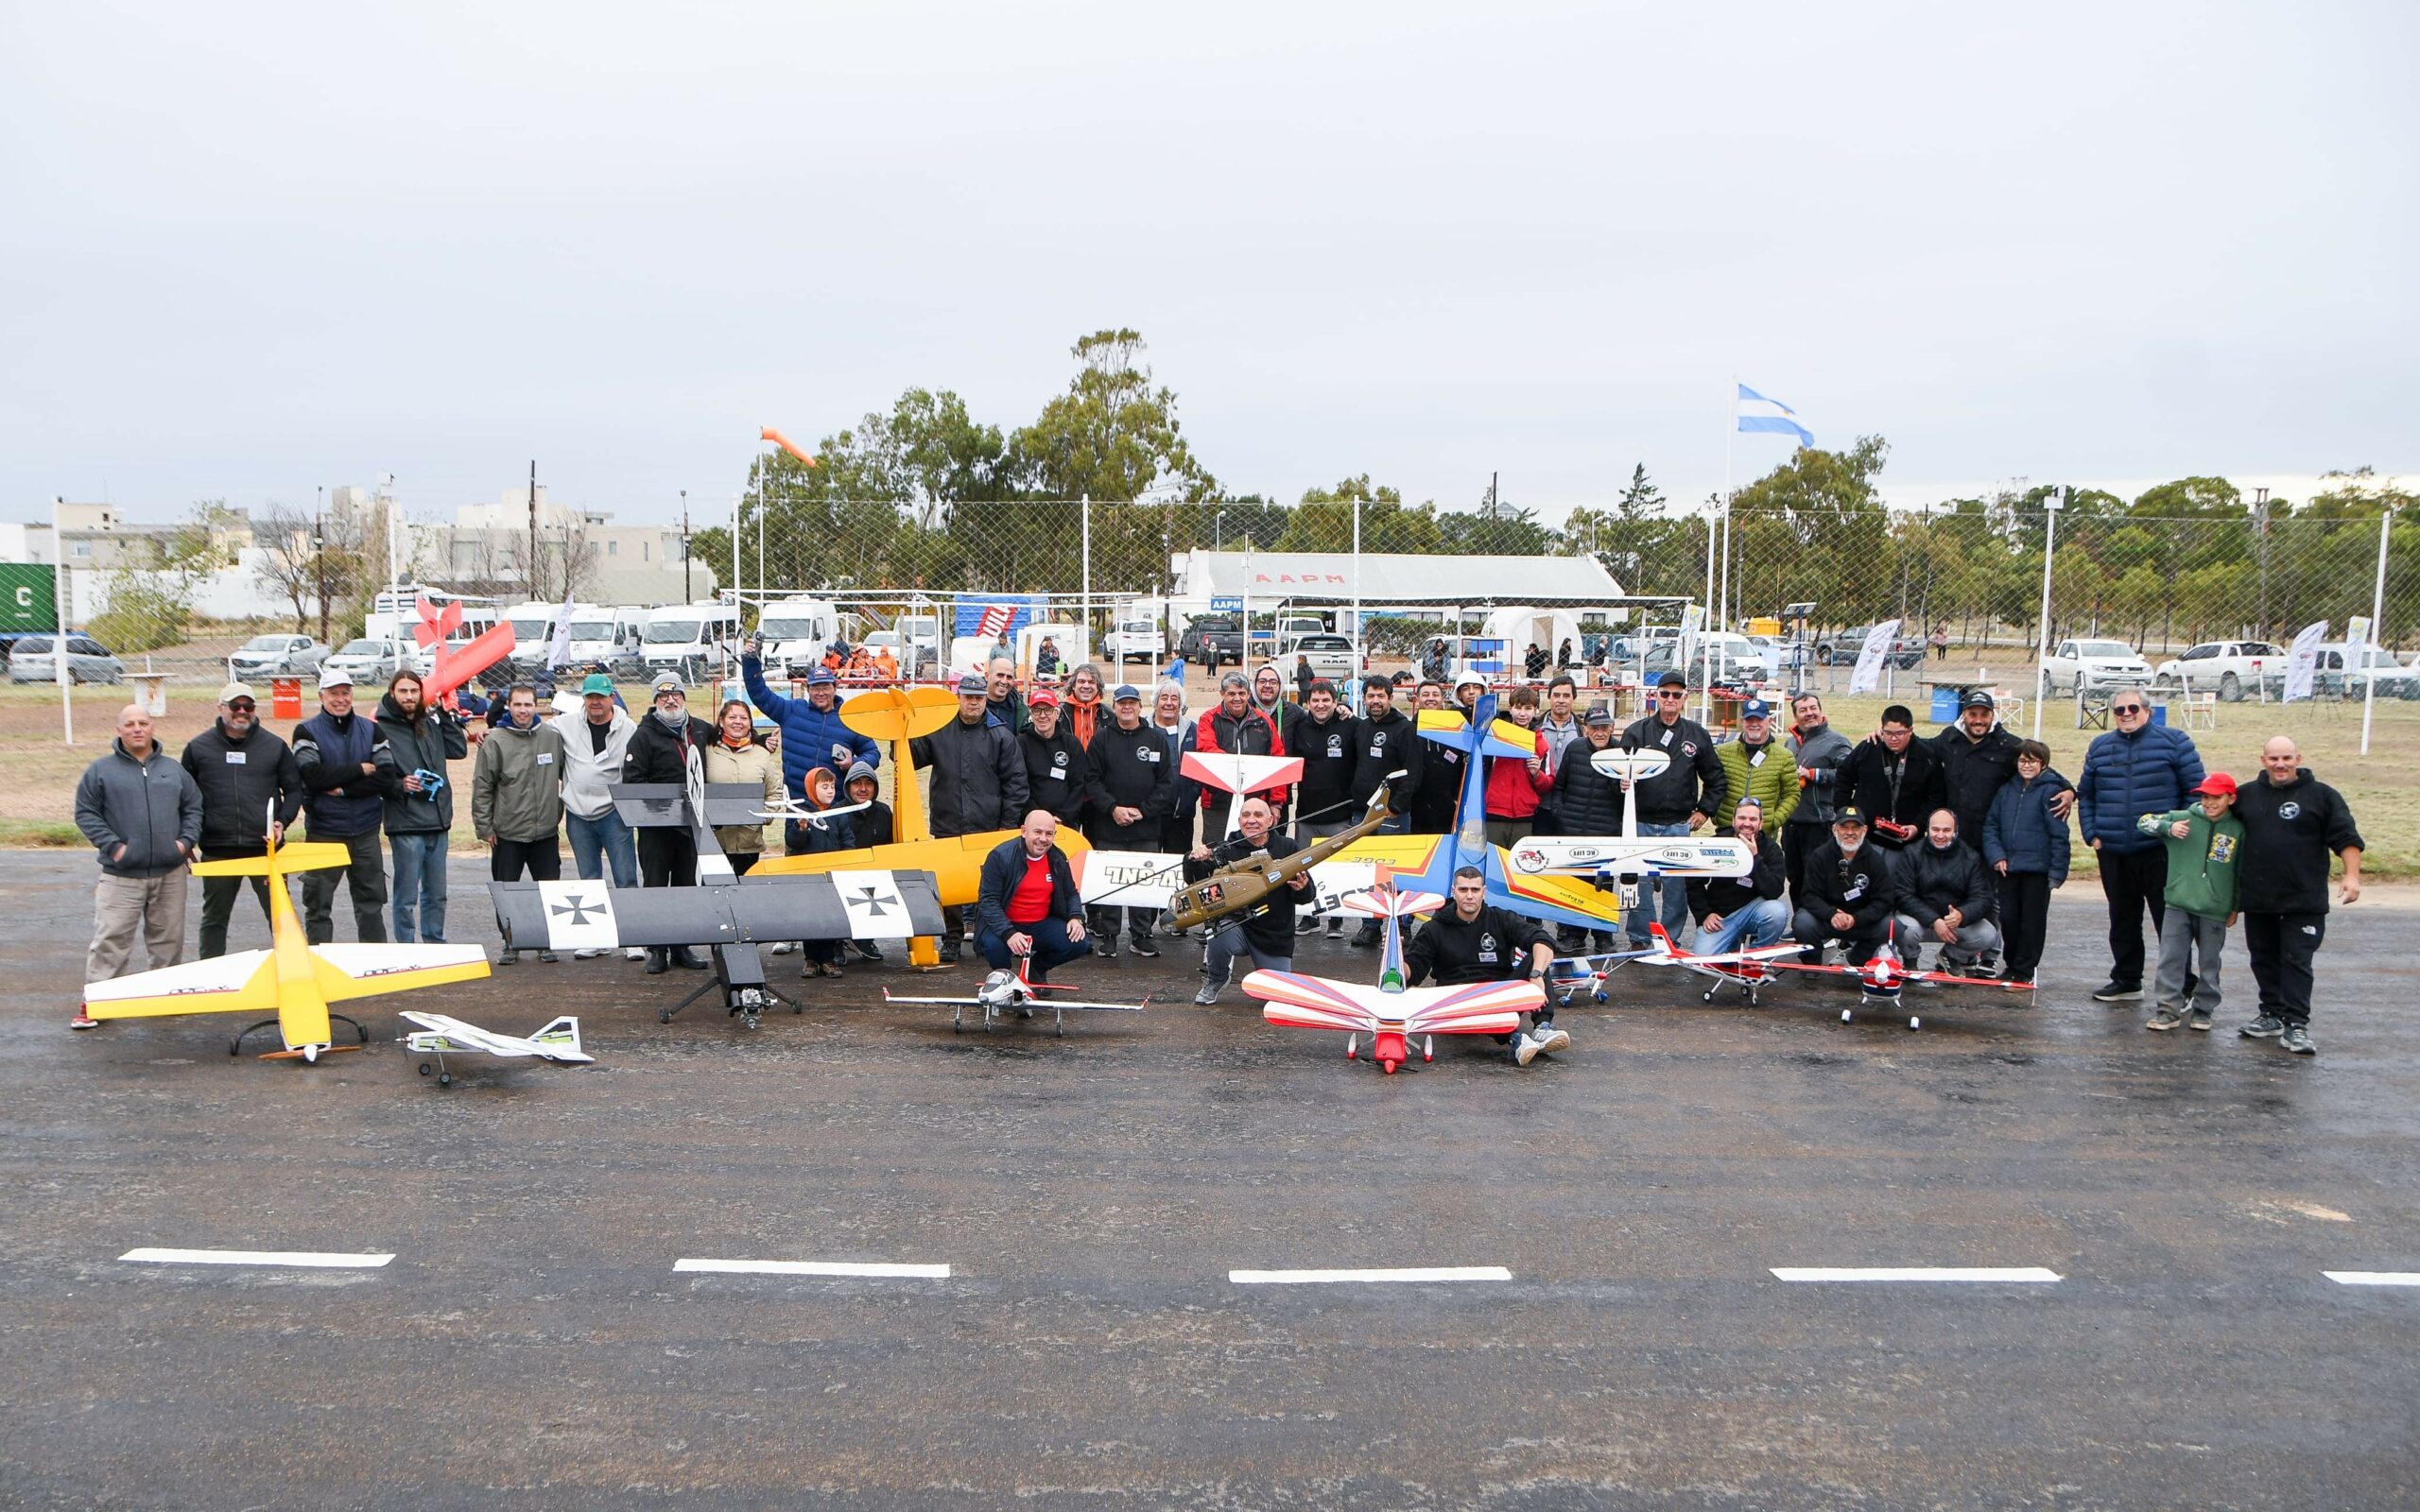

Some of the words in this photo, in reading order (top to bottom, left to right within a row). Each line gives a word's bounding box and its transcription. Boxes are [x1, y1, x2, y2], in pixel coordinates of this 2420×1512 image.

[1255, 574, 1344, 583] AAPM
[1213, 600, 1242, 610] AAPM
[1354, 856, 1396, 865] EDGE
